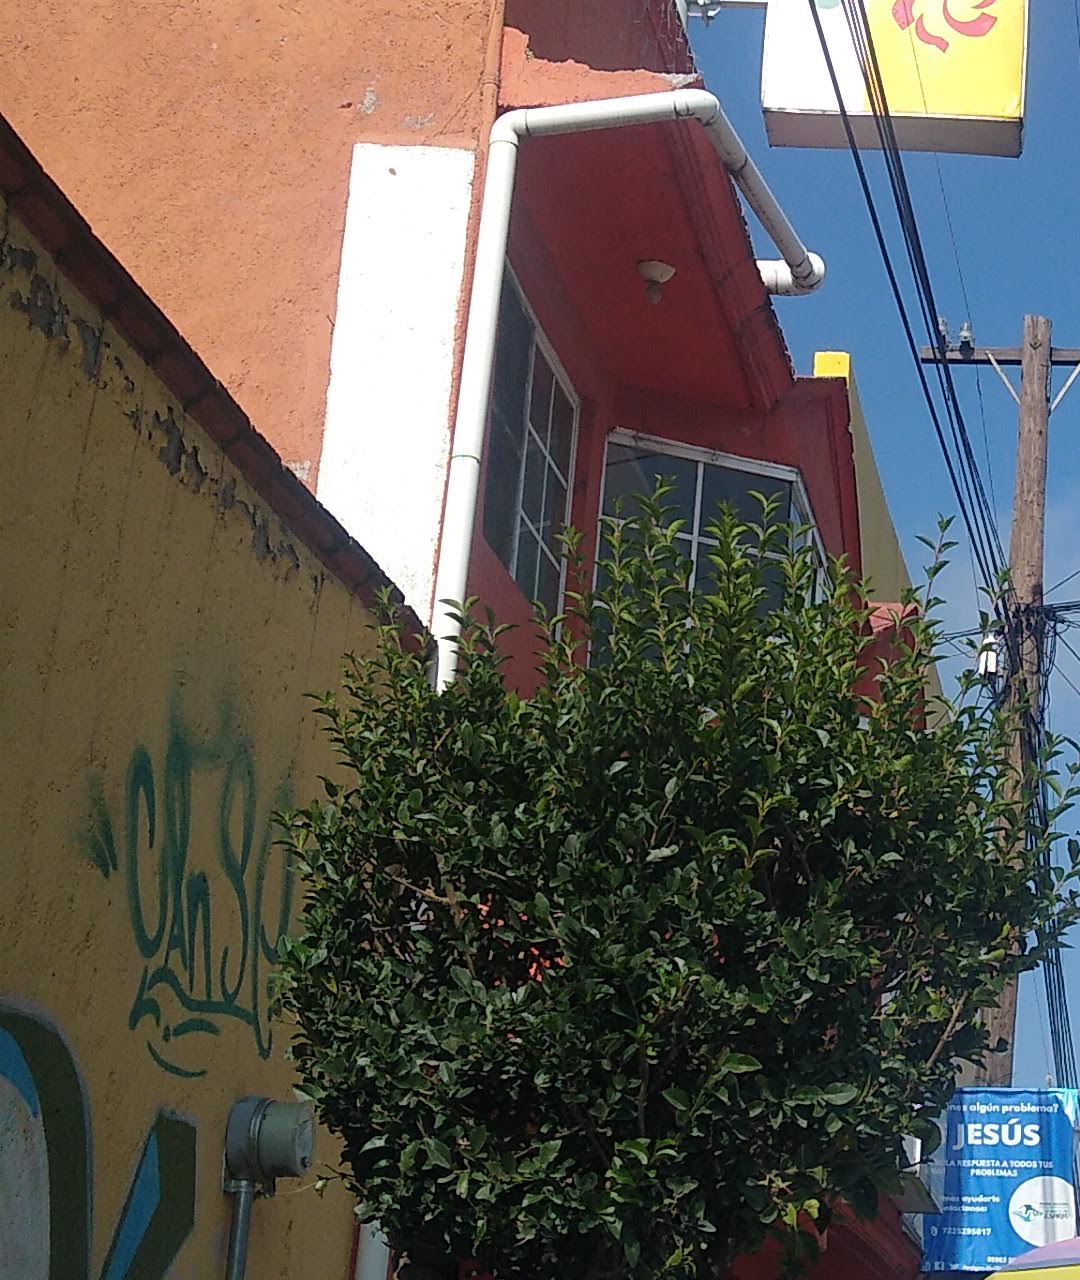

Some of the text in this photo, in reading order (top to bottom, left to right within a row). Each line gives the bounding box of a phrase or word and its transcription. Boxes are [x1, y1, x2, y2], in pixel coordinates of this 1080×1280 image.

[969, 1102, 999, 1114] algún
[1001, 1102, 1058, 1114] problema?
[952, 1118, 1040, 1151] JESÚS
[1001, 1160, 1009, 1168] A
[1039, 1161, 1054, 1169] TUS
[970, 1169, 1018, 1177] PROBLEMAS
